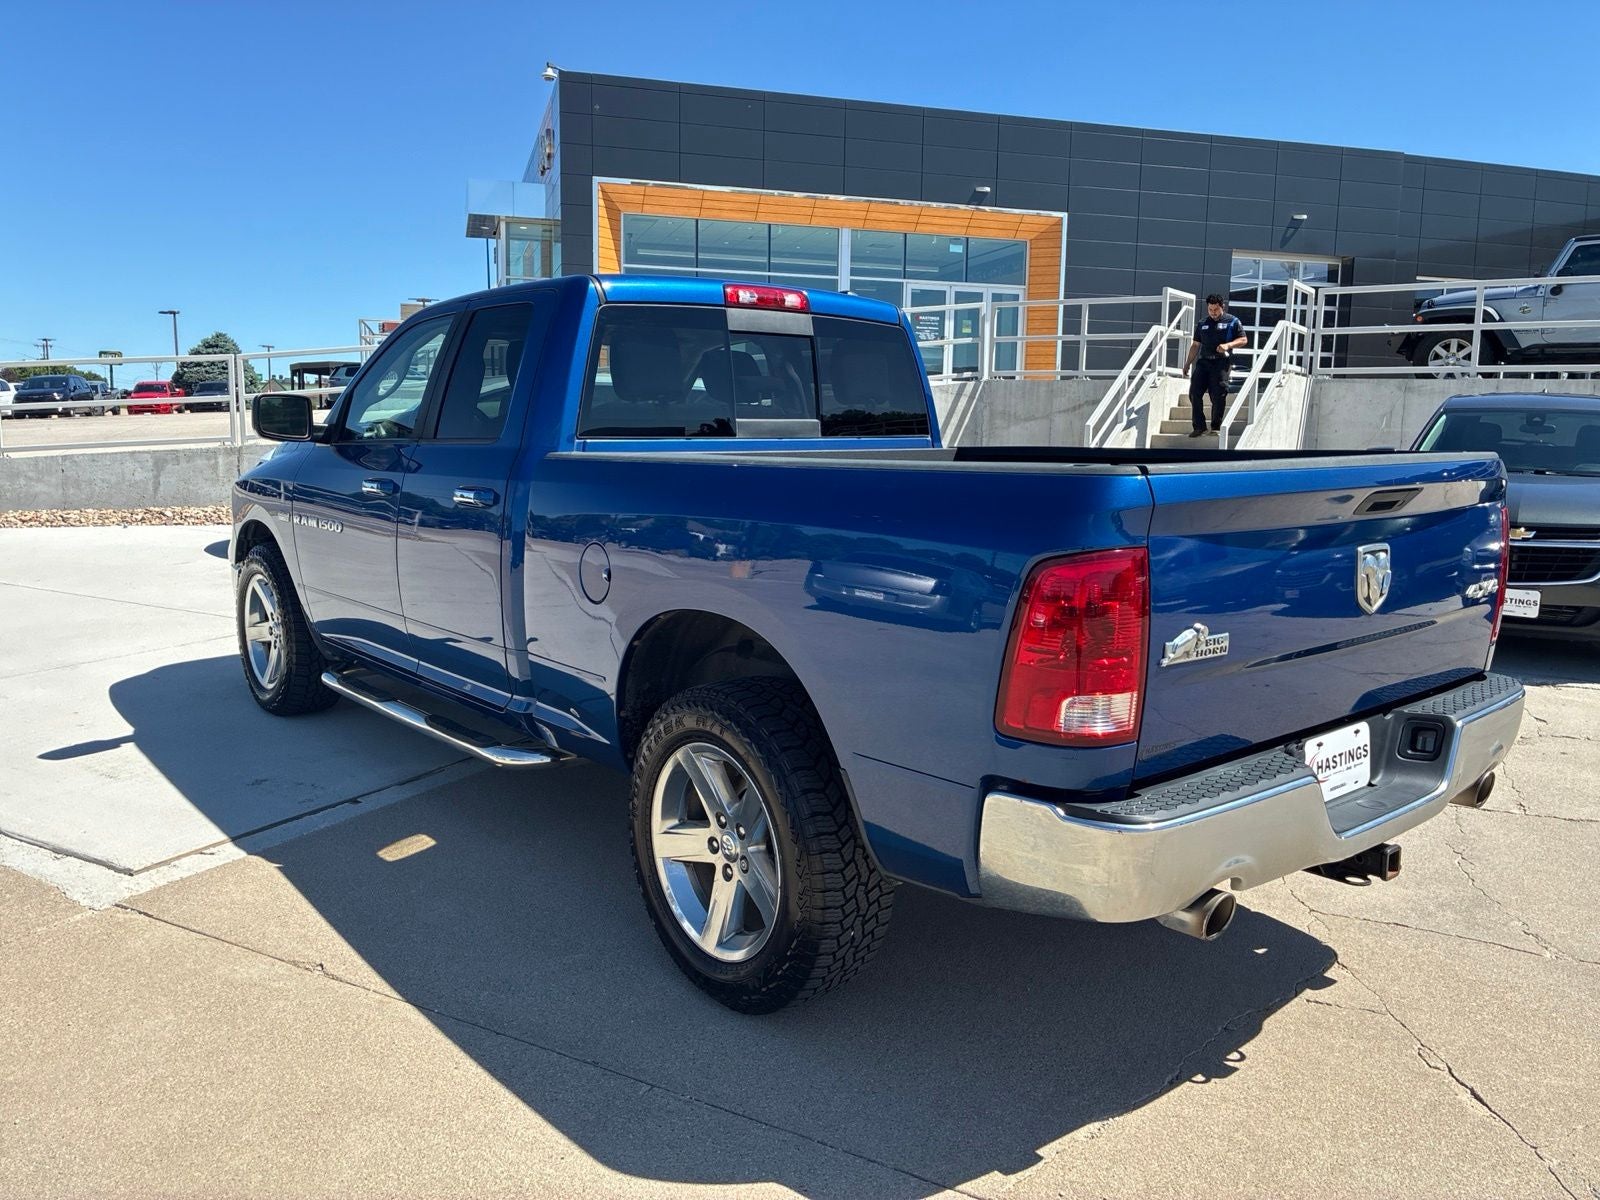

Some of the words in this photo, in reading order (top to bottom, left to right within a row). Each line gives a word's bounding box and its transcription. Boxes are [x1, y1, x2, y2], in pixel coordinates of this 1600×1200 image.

[294, 514, 318, 528] RAM
[319, 518, 343, 533] 1500
[1205, 636, 1224, 647] BIG
[1196, 645, 1228, 657] HORN
[1316, 743, 1369, 775] HASTINGS
